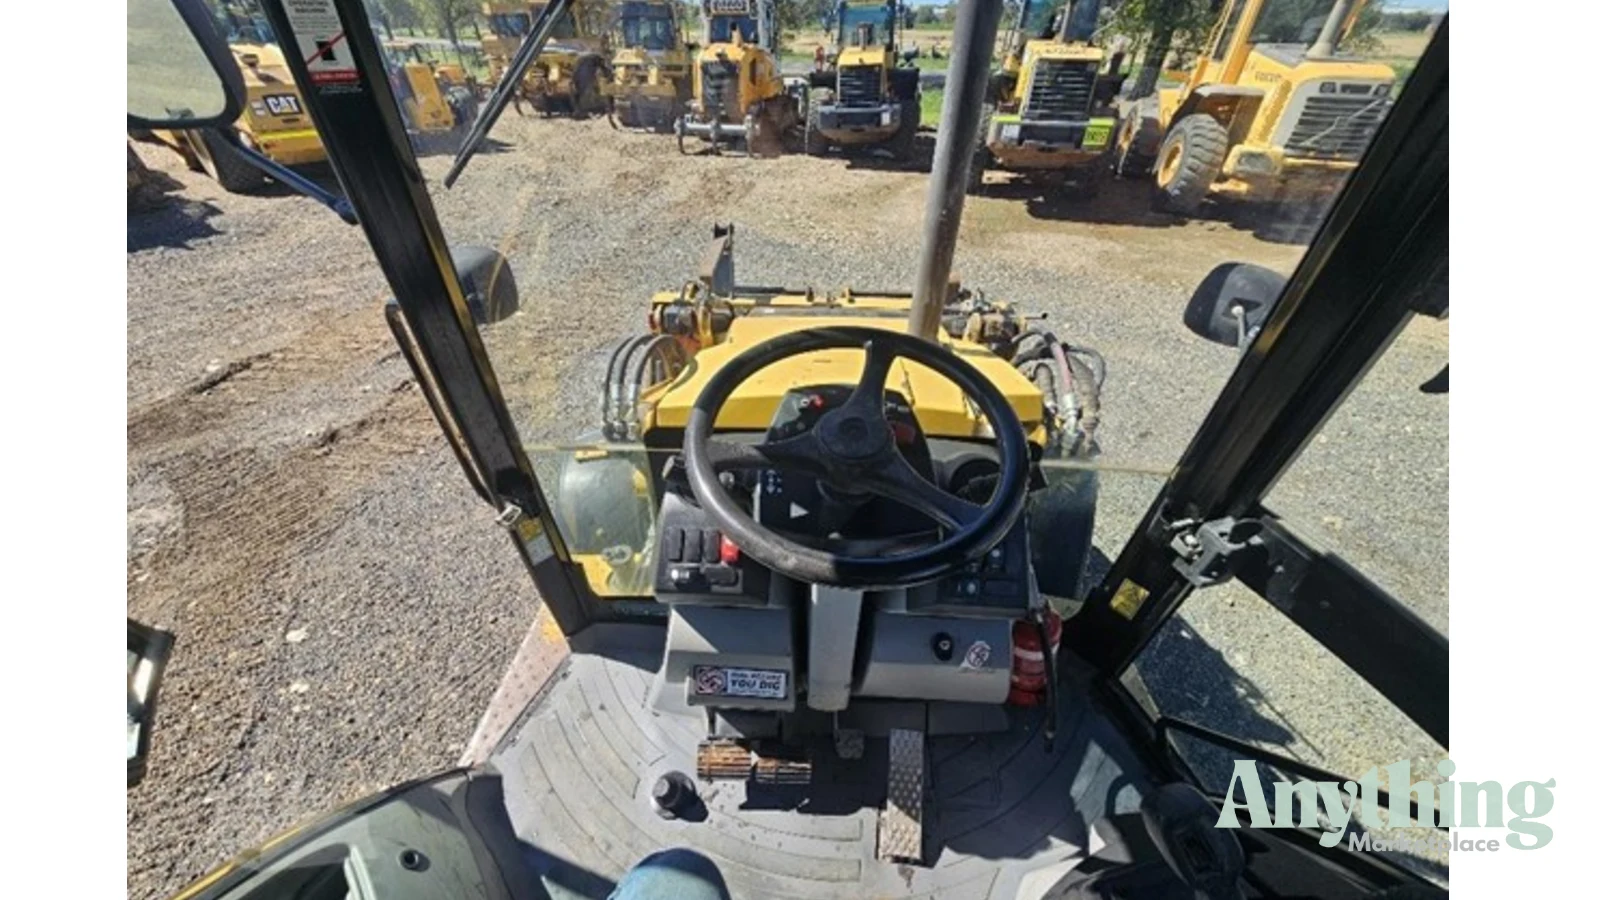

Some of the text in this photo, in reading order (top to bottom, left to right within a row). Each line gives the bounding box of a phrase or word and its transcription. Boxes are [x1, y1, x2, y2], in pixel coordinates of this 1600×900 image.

[266, 96, 300, 113] CAT
[731, 679, 780, 691] YOU DIG
